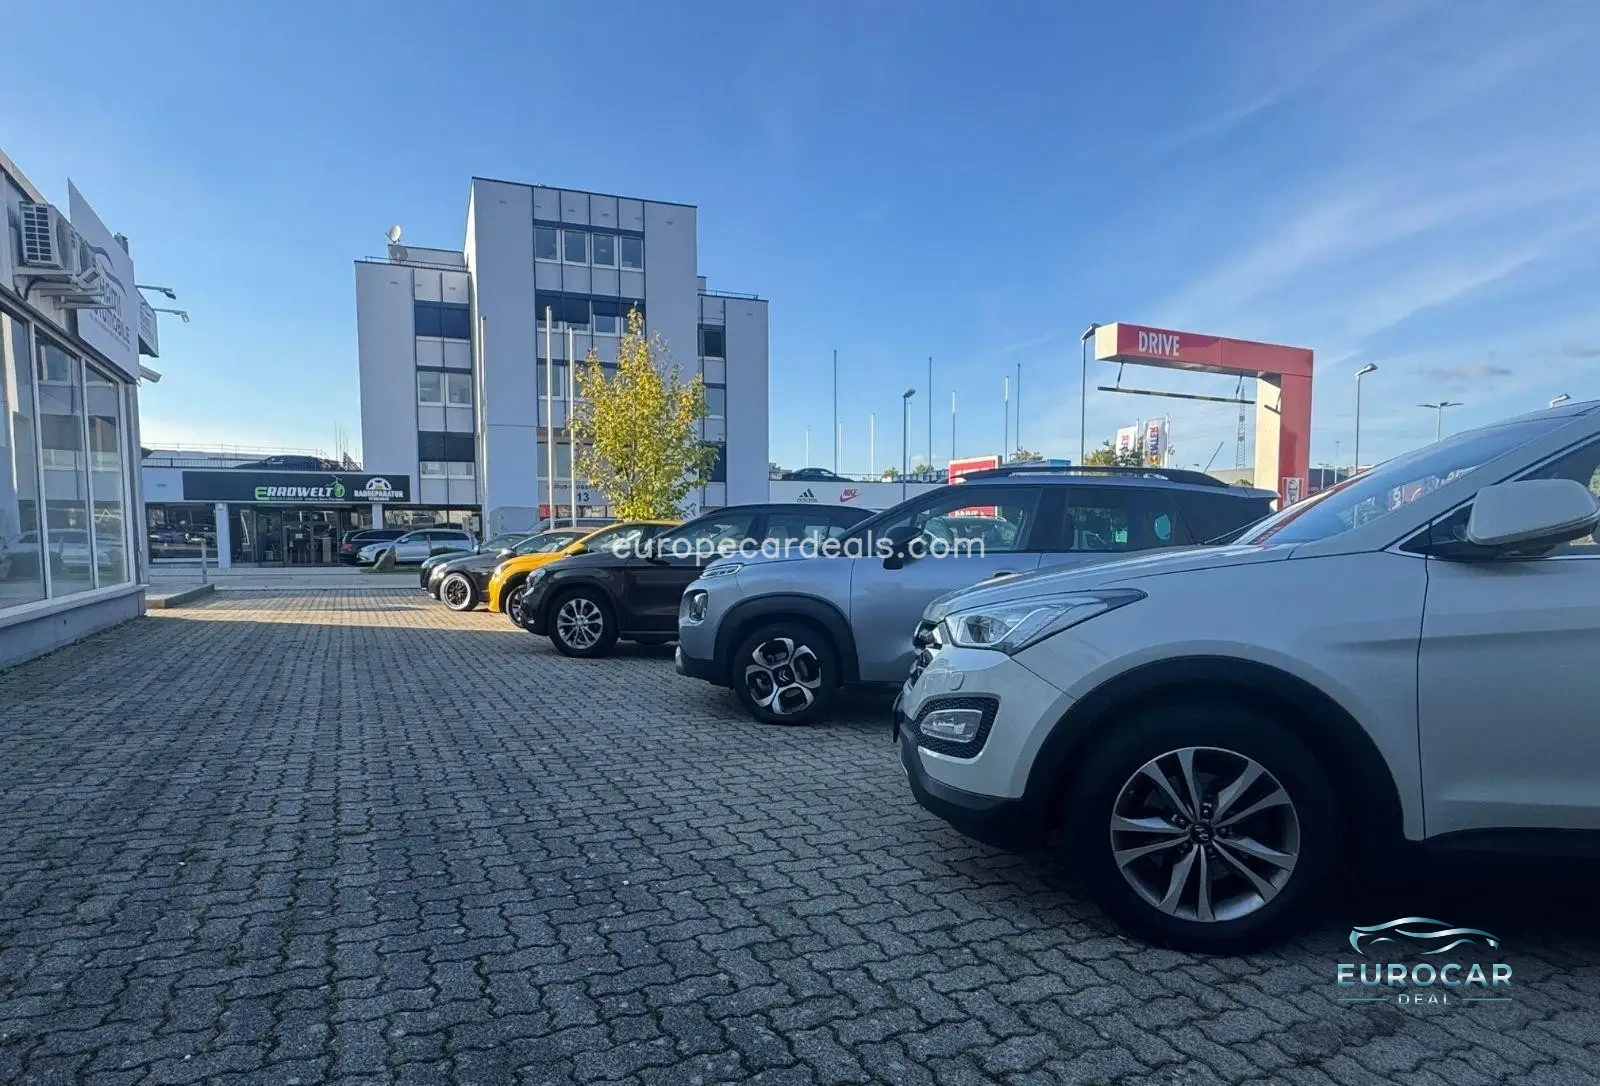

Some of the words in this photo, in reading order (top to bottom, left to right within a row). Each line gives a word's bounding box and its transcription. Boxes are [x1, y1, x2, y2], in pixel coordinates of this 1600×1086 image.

[1138, 330, 1181, 357] DRIVE
[576, 492, 590, 502] 13
[842, 488, 858, 497] NIKE
